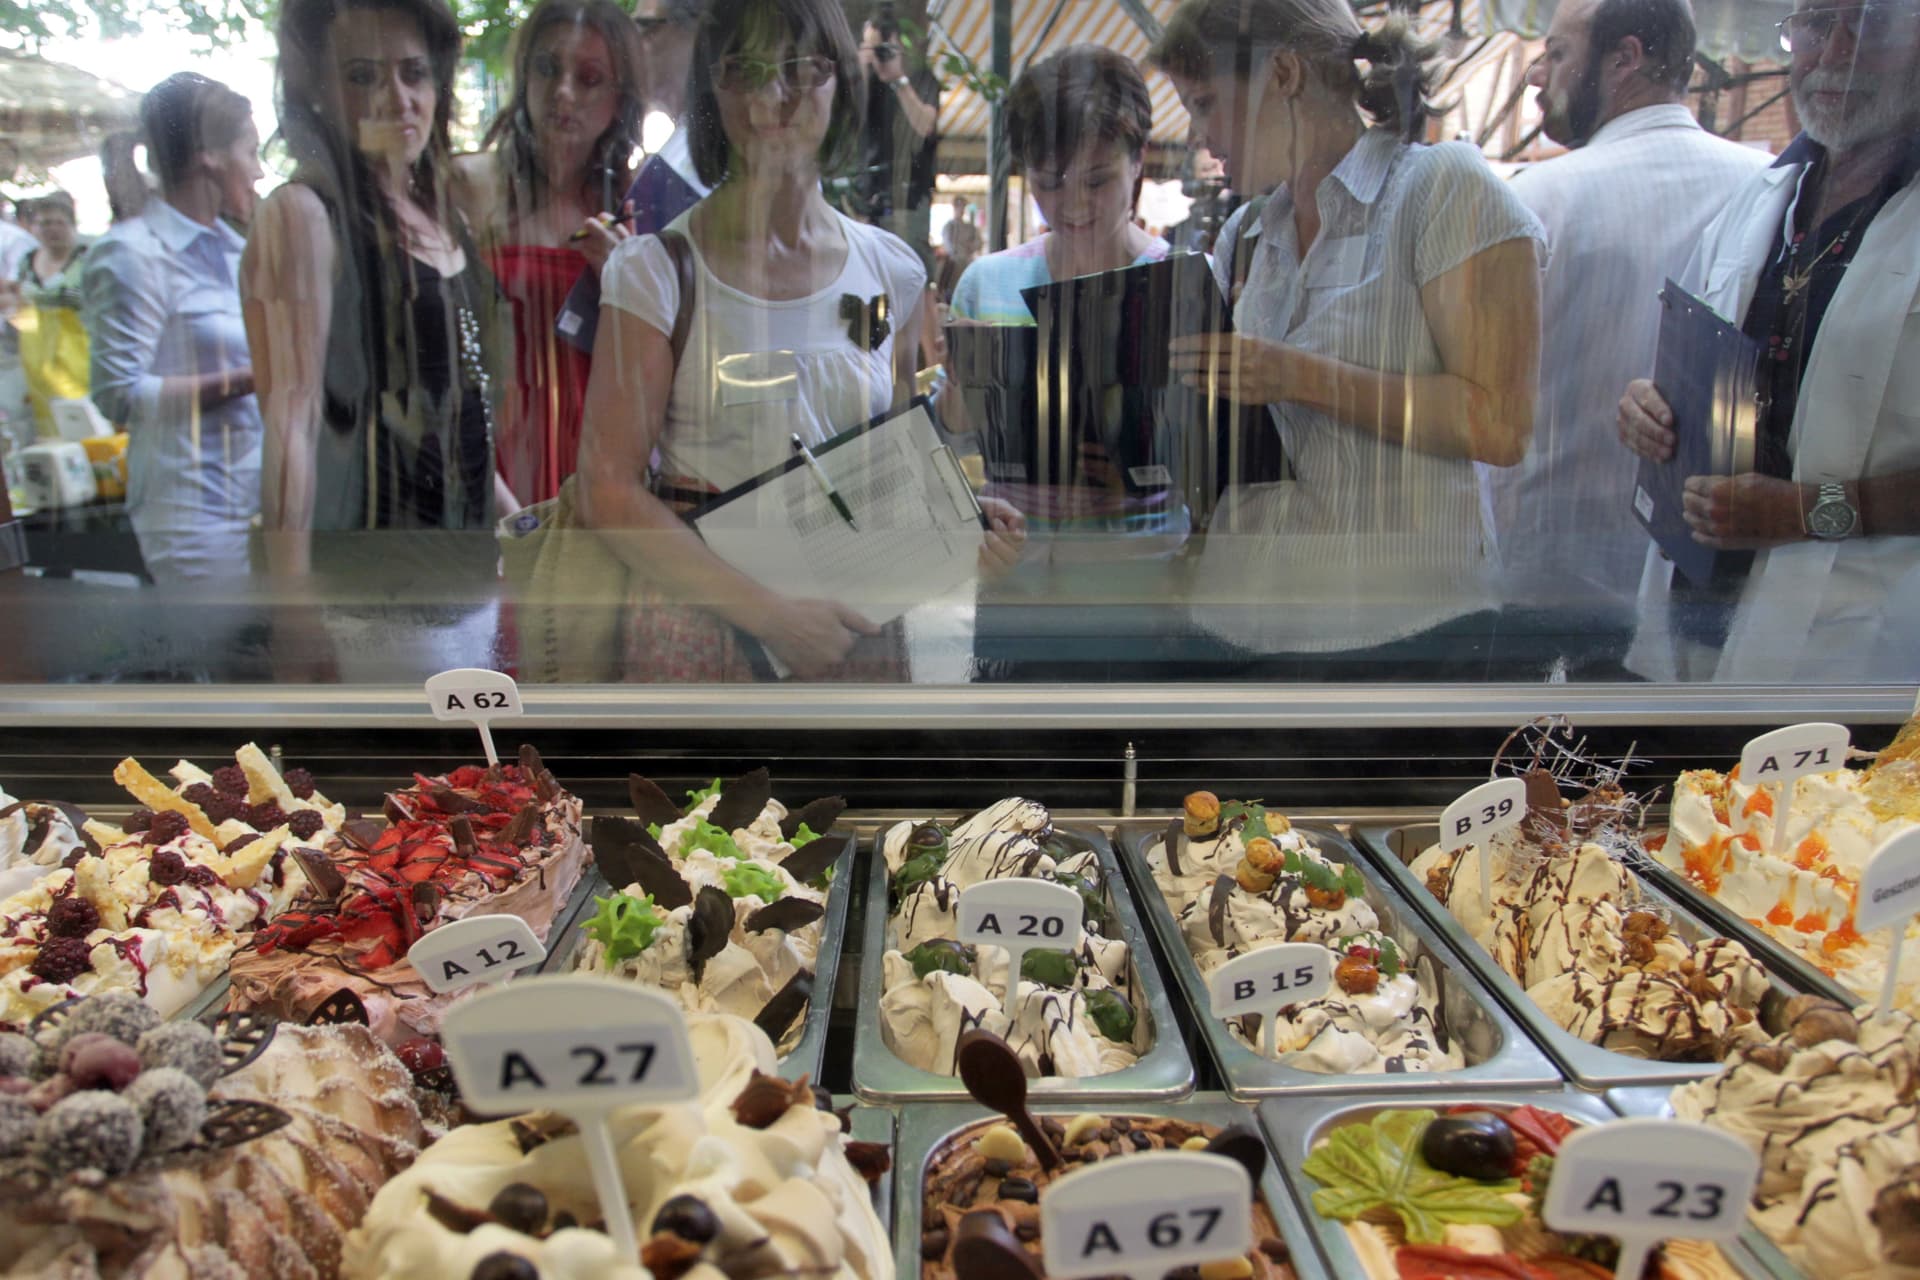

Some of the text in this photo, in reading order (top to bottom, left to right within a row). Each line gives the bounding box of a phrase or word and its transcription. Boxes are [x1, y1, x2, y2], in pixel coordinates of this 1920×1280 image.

[448, 692, 510, 710] A 62
[1758, 747, 1830, 774] A 71
[1455, 798, 1513, 837] B 39
[976, 913, 1064, 938] A 20
[443, 941, 526, 981] A 12
[1234, 965, 1314, 1001] B 15
[500, 1043, 658, 1091] A 27
[1584, 1177, 1726, 1221] A 23
[1081, 1207, 1223, 1258] A 67
